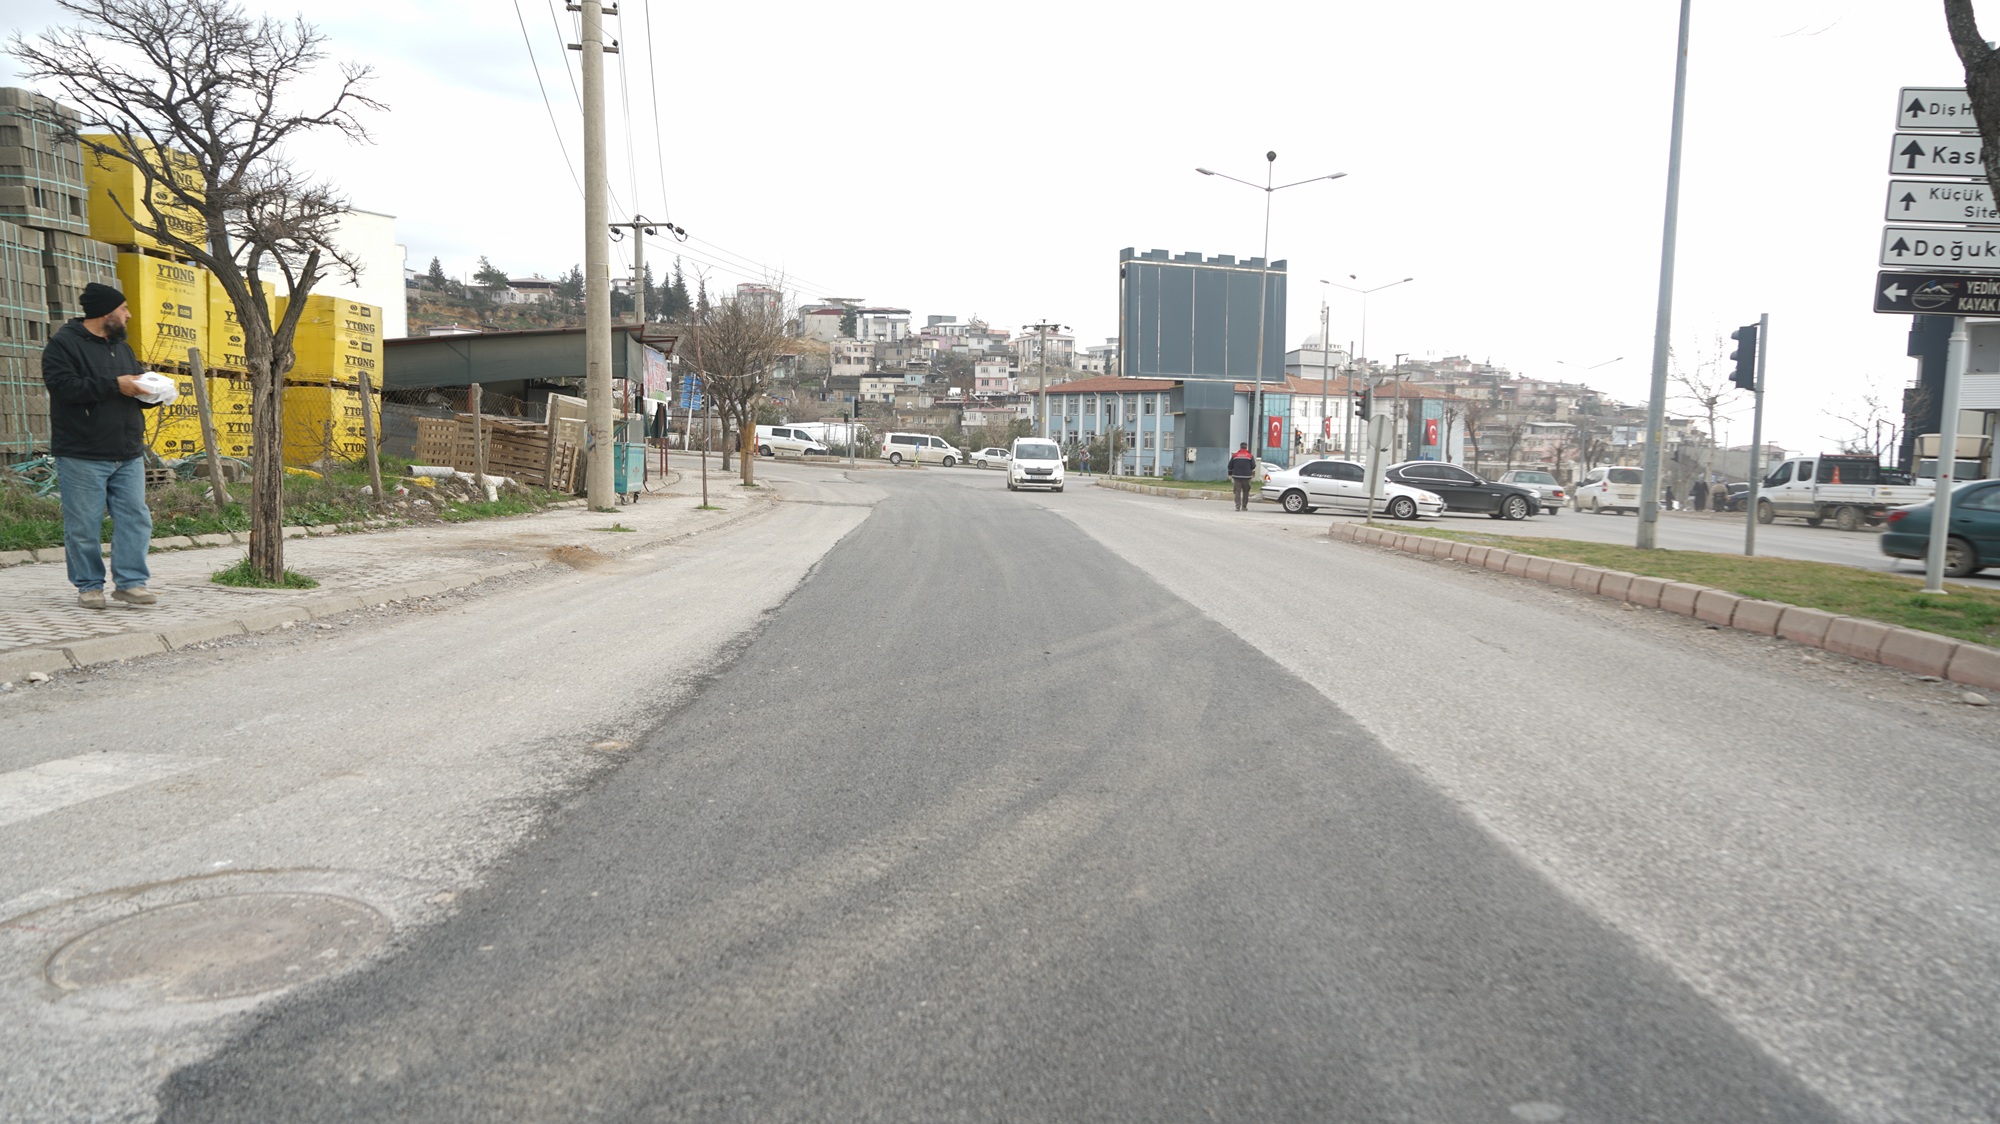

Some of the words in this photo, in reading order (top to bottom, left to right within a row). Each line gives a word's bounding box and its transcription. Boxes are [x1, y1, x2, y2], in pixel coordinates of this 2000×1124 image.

[1929, 102, 1956, 117] Diş
[1960, 103, 1974, 115] H
[1929, 187, 1984, 202] Küçük
[1964, 205, 2000, 219] Site
[1914, 240, 2000, 261] Doğuk
[156, 263, 195, 283] YTONG
[1958, 297, 1996, 312] KAYAK
[156, 322, 196, 340] YTONG
[345, 319, 375, 333] YTONG
[224, 353, 249, 367] YTO
[344, 354, 375, 368] YTONG
[343, 405, 363, 416] YTO
